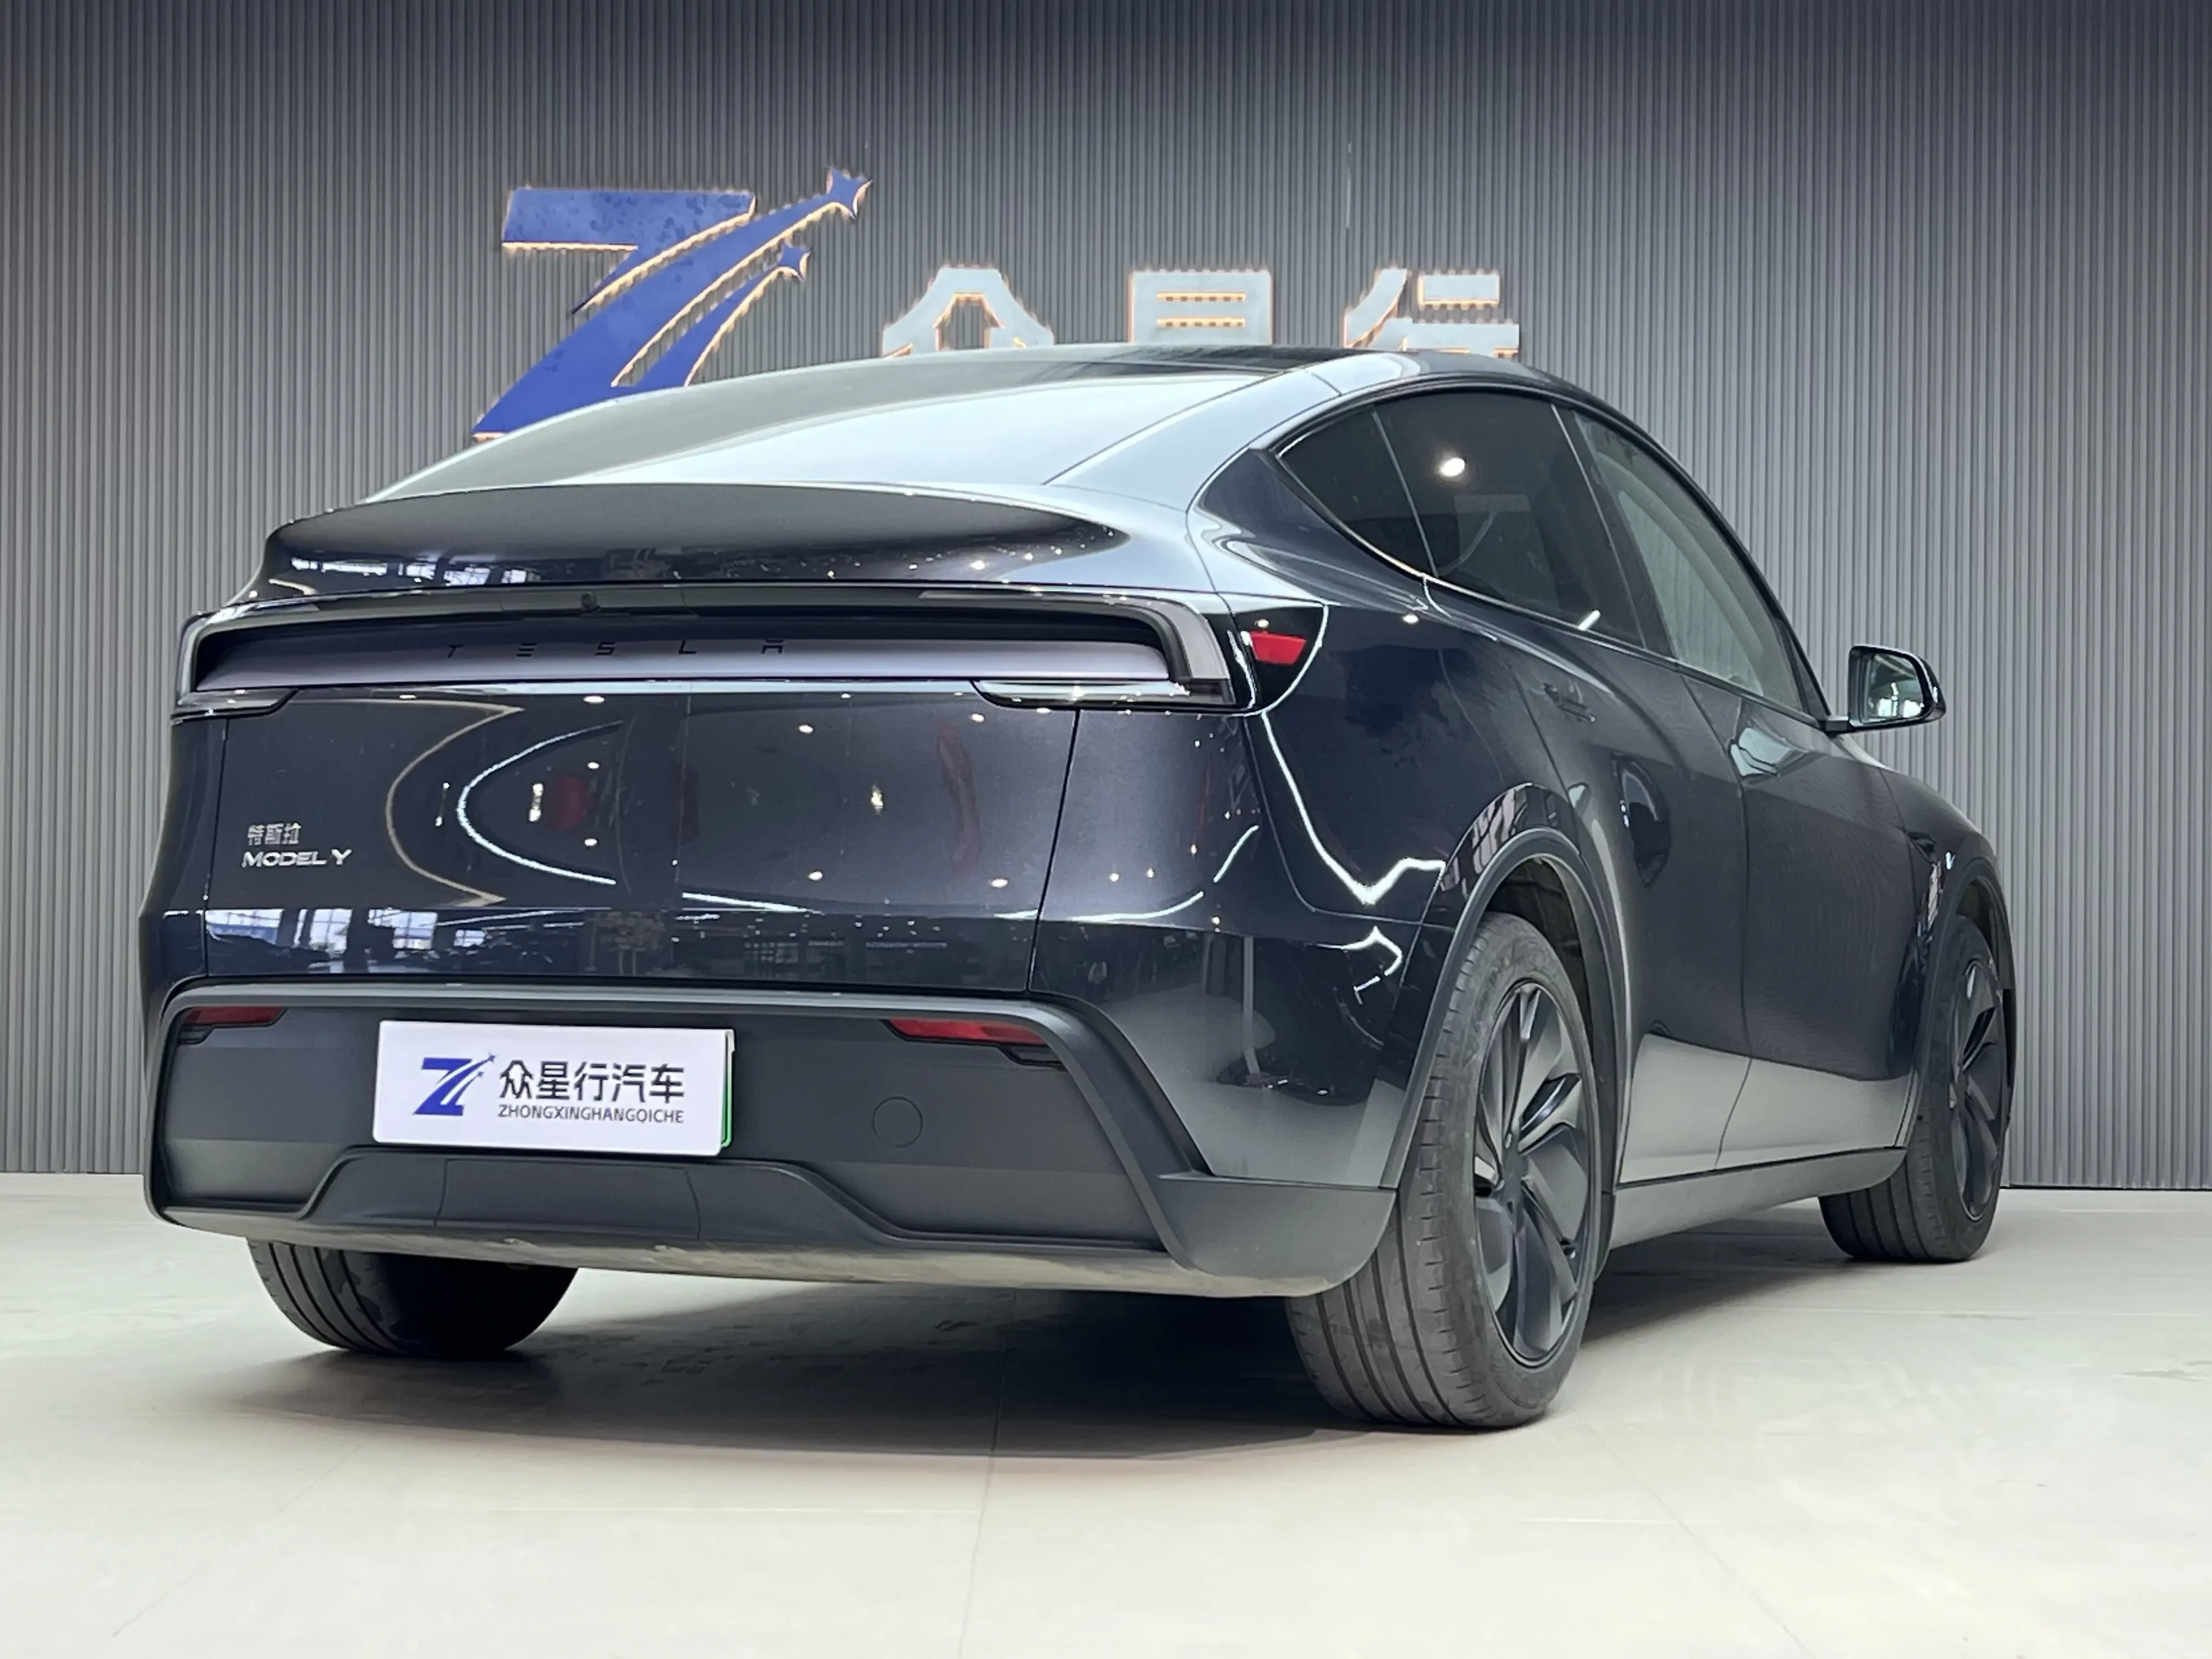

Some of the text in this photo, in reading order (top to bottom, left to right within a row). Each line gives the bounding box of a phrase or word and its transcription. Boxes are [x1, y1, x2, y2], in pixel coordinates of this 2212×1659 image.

[447, 639, 785, 658] TESLA
[247, 822, 301, 846] 特斯拉
[241, 849, 352, 867] MODEL Y
[499, 1059, 685, 1104] 众星行汽车
[497, 1104, 684, 1124] ZHONGXINGHANGQICHE
